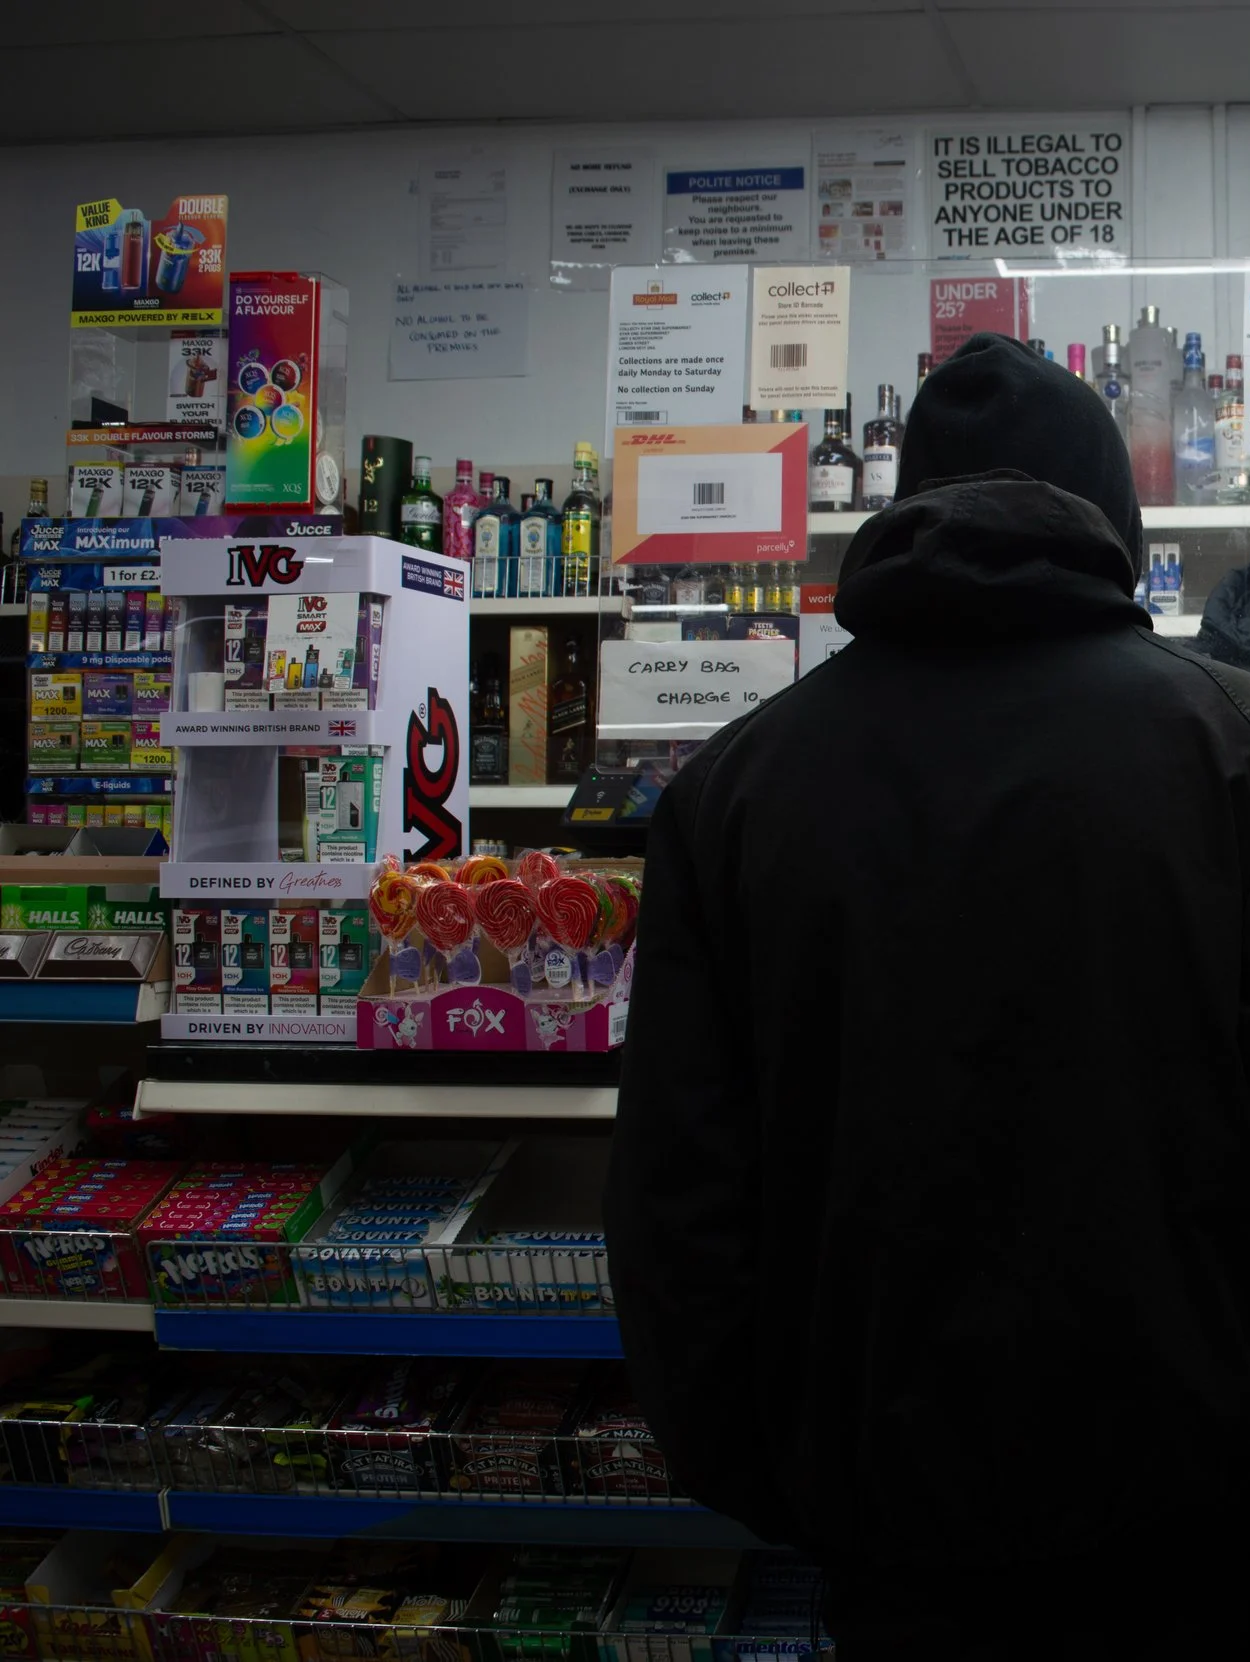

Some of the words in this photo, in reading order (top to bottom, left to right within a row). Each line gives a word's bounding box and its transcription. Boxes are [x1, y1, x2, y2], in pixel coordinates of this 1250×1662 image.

[934, 137, 957, 156] IT
[960, 136, 981, 155] IS
[987, 134, 1085, 155] ILLEGAL
[1090, 133, 1123, 152] TO
[937, 158, 997, 179] SELL
[1001, 156, 1120, 178] TOBACCO
[688, 175, 732, 188] POLITE
[735, 174, 782, 187] NOTICE
[944, 179, 1075, 201] PRODUCTS
[1080, 178, 1113, 198] TO
[691, 194, 723, 204] Please
[725, 193, 760, 205] respect
[762, 193, 778, 201] our
[81, 201, 111, 218] VALUE
[178, 198, 225, 215] DOUBLE
[934, 204, 1034, 224] ANYONE
[1040, 202, 1123, 222] UNDER
[85, 213, 110, 229] KING
[688, 215, 705, 224] You
[707, 216, 724, 224] are
[725, 213, 772, 224] requested
[773, 213, 783, 222] to
[678, 226, 701, 238] keep
[703, 225, 729, 235] noise
[730, 226, 740, 234] to
[742, 226, 748, 234] a
[750, 223, 793, 233] minimum
[943, 227, 990, 247] THE
[994, 226, 1045, 246] AGE
[1050, 225, 1083, 245] OF
[1091, 224, 1115, 244] 18
[691, 237, 716, 247] when
[719, 236, 752, 248] leaving
[754, 234, 780, 245] these
[76, 252, 102, 272] 12K
[199, 248, 222, 265] 33K
[768, 281, 834, 298] collect+
[935, 282, 998, 300] UNDER
[235, 295, 253, 306] DO
[253, 294, 309, 305] YOURSELF
[235, 305, 244, 316] A
[244, 304, 294, 316] FLAVOUR
[935, 302, 965, 318] 25?
[78, 314, 115, 325] MAXGO
[117, 313, 165, 323] POWERED
[166, 312, 178, 322] BY
[181, 311, 215, 322] RELX
[618, 356, 663, 366] Collections
[664, 357, 679, 365] are
[680, 356, 704, 365] made
[705, 356, 725, 365] once
[618, 368, 638, 379] daily
[640, 368, 672, 378] Monday
[673, 368, 683, 377] to
[684, 367, 722, 378] Saturday
[617, 386, 629, 395] No
[631, 385, 671, 395] collection
[672, 386, 683, 394] on
[684, 384, 716, 395] Sunday
[175, 402, 215, 410] SWITCH
[181, 410, 209, 418] YOUR
[70, 433, 89, 443] 33K
[93, 432, 130, 443] DOUBLE
[131, 431, 173, 442] FLAVOUR
[175, 430, 215, 441] STORMS
[631, 433, 678, 446] DHL
[282, 482, 303, 495] XQS
[77, 526, 117, 535] Introducing
[286, 521, 333, 536] JUCCE
[33, 540, 60, 552] MAX
[75, 535, 155, 551] MAXimum
[756, 542, 789, 554] parcelly
[226, 544, 305, 588] IVG
[403, 561, 421, 573] AWARD
[421, 565, 442, 579] WINNING
[110, 571, 116, 581] 1
[118, 569, 138, 582] for
[139, 569, 161, 582] £2.
[406, 571, 425, 583] BRITISH
[425, 576, 442, 588] BRAND
[297, 595, 328, 613] IVG
[296, 612, 328, 620] SMART
[299, 622, 323, 633] MAX
[226, 639, 241, 662] 12
[81, 655, 88, 665] 9
[90, 656, 103, 666] mg
[105, 655, 151, 665] Disposable
[152, 655, 173, 667] pods
[628, 660, 689, 674] CARRY
[700, 660, 741, 674] BAG
[656, 690, 731, 705] CHARGE
[175, 725, 208, 734] AWARD
[210, 724, 251, 733] WINNING
[252, 723, 287, 733] BRITISH
[288, 723, 321, 733] BRAND
[95, 780, 131, 791] E-liquids
[189, 877, 252, 889] DEFINED
[255, 876, 276, 889] BY
[279, 871, 343, 892] Greatness
[271, 943, 288, 967] 12
[188, 1022, 243, 1035] DRIVEN
[246, 1022, 265, 1035] BY
[269, 1021, 347, 1036] INNOVATION
[337, 1230, 421, 1242] BOUNTY
[474, 1284, 564, 1302] BOUNTY
